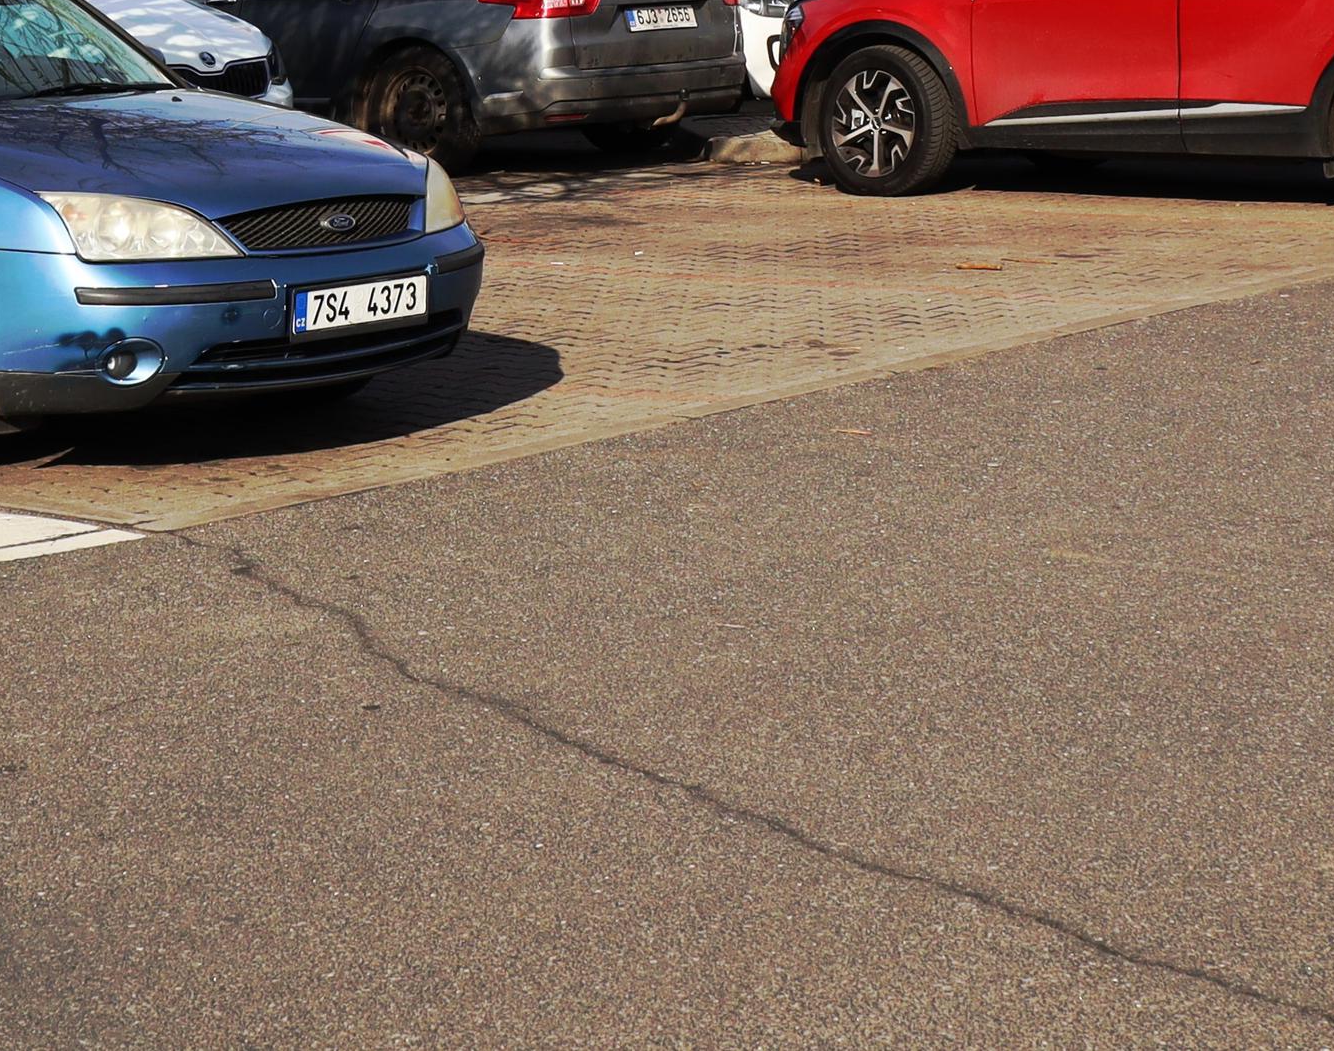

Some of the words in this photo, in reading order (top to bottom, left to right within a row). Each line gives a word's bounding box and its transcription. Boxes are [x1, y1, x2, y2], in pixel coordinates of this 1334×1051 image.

[636, 9, 658, 25] 6J3
[666, 7, 691, 23] 2656
[312, 291, 350, 326] 7S4
[367, 282, 417, 316] 4373
[296, 319, 306, 327] CZ
